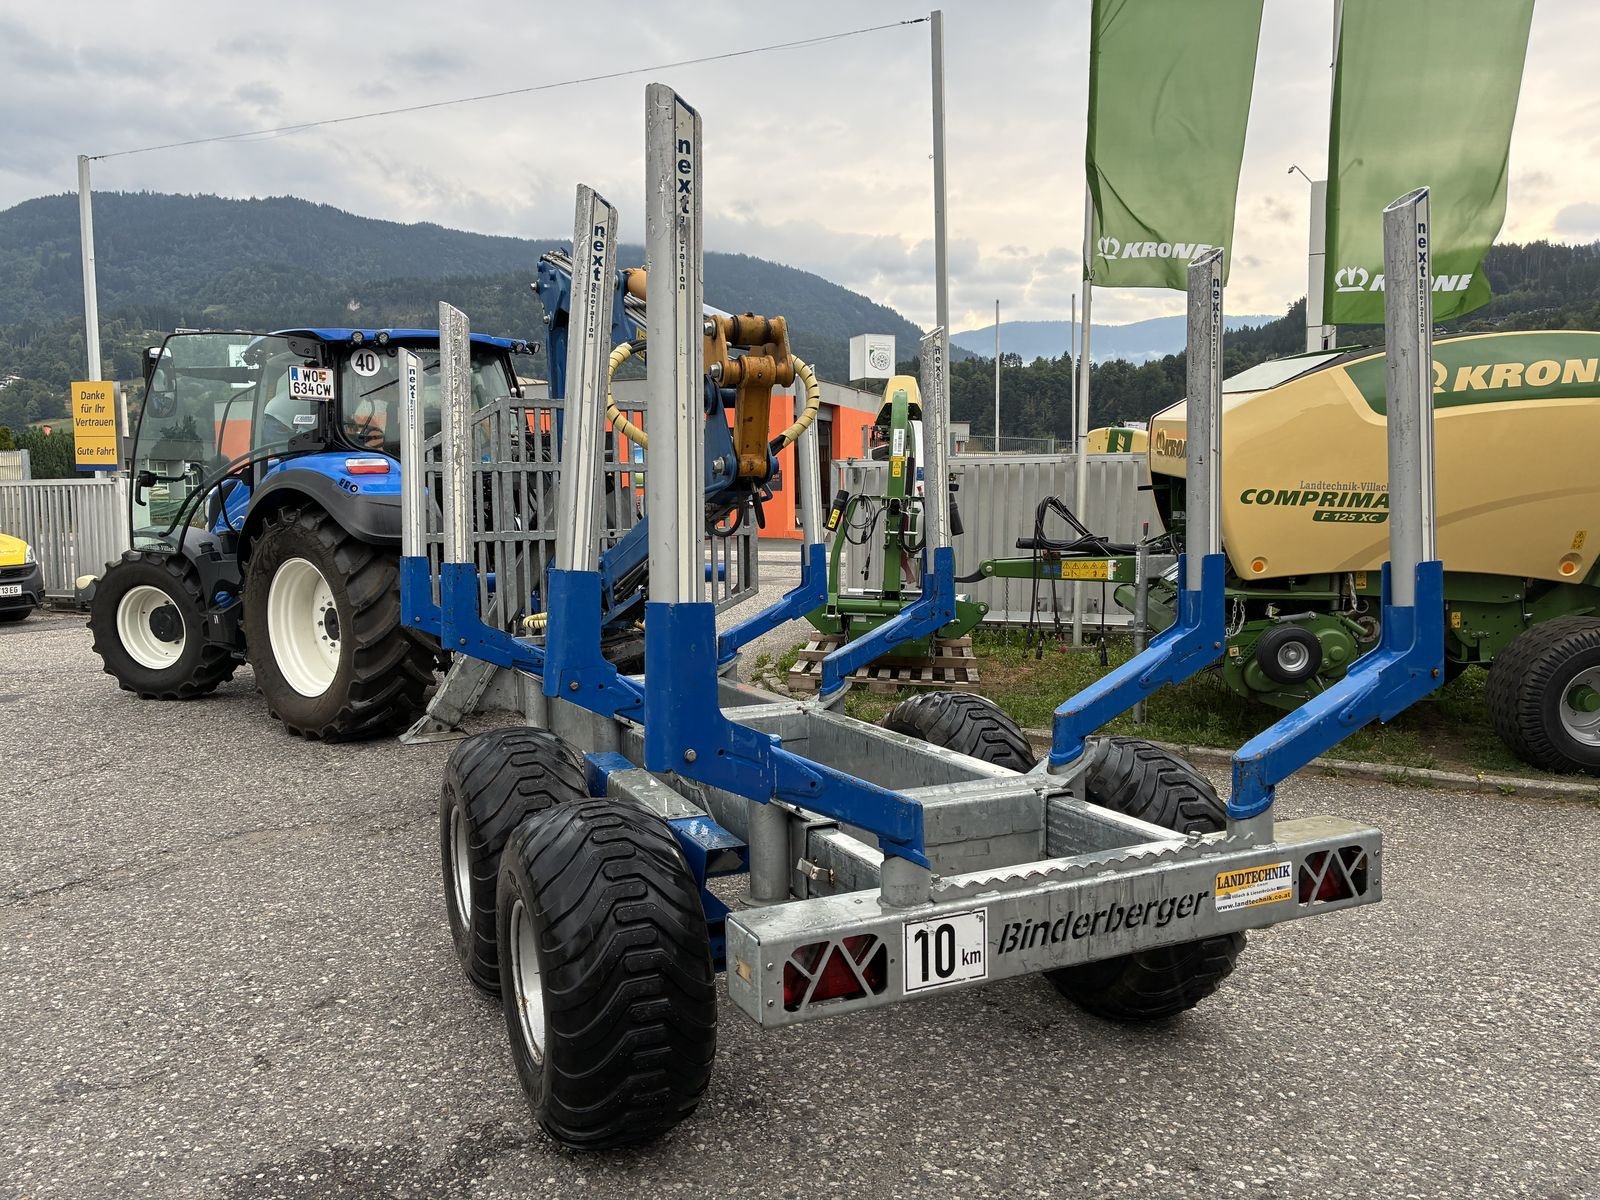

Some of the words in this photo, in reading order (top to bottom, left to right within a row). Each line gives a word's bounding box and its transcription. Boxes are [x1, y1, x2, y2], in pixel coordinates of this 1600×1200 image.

[677, 138, 692, 214] next
[591, 225, 606, 281] next
[1417, 222, 1427, 278] next
[588, 283, 597, 338] generation
[355, 353, 375, 372] 40
[303, 370, 318, 382] WO
[409, 368, 417, 399] next
[1453, 358, 1600, 392] KRON
[80, 390, 105, 400] Danke
[81, 403, 92, 413] für
[94, 404, 105, 413] Ihr
[75, 418, 113, 427] Vertrauen
[77, 447, 94, 456] Gute
[96, 447, 115, 456] Fahrt
[1240, 489, 1389, 509] COMPRIMA
[1321, 513, 1330, 521] F
[1334, 513, 1356, 521] 125
[1359, 513, 1379, 522] XC
[1217, 865, 1290, 889] LANDTECHNIK
[1217, 893, 1291, 911] www.landtechnik.co.at
[998, 890, 1209, 955] Binderberger
[914, 923, 956, 983] 10
[962, 948, 981, 966] km
